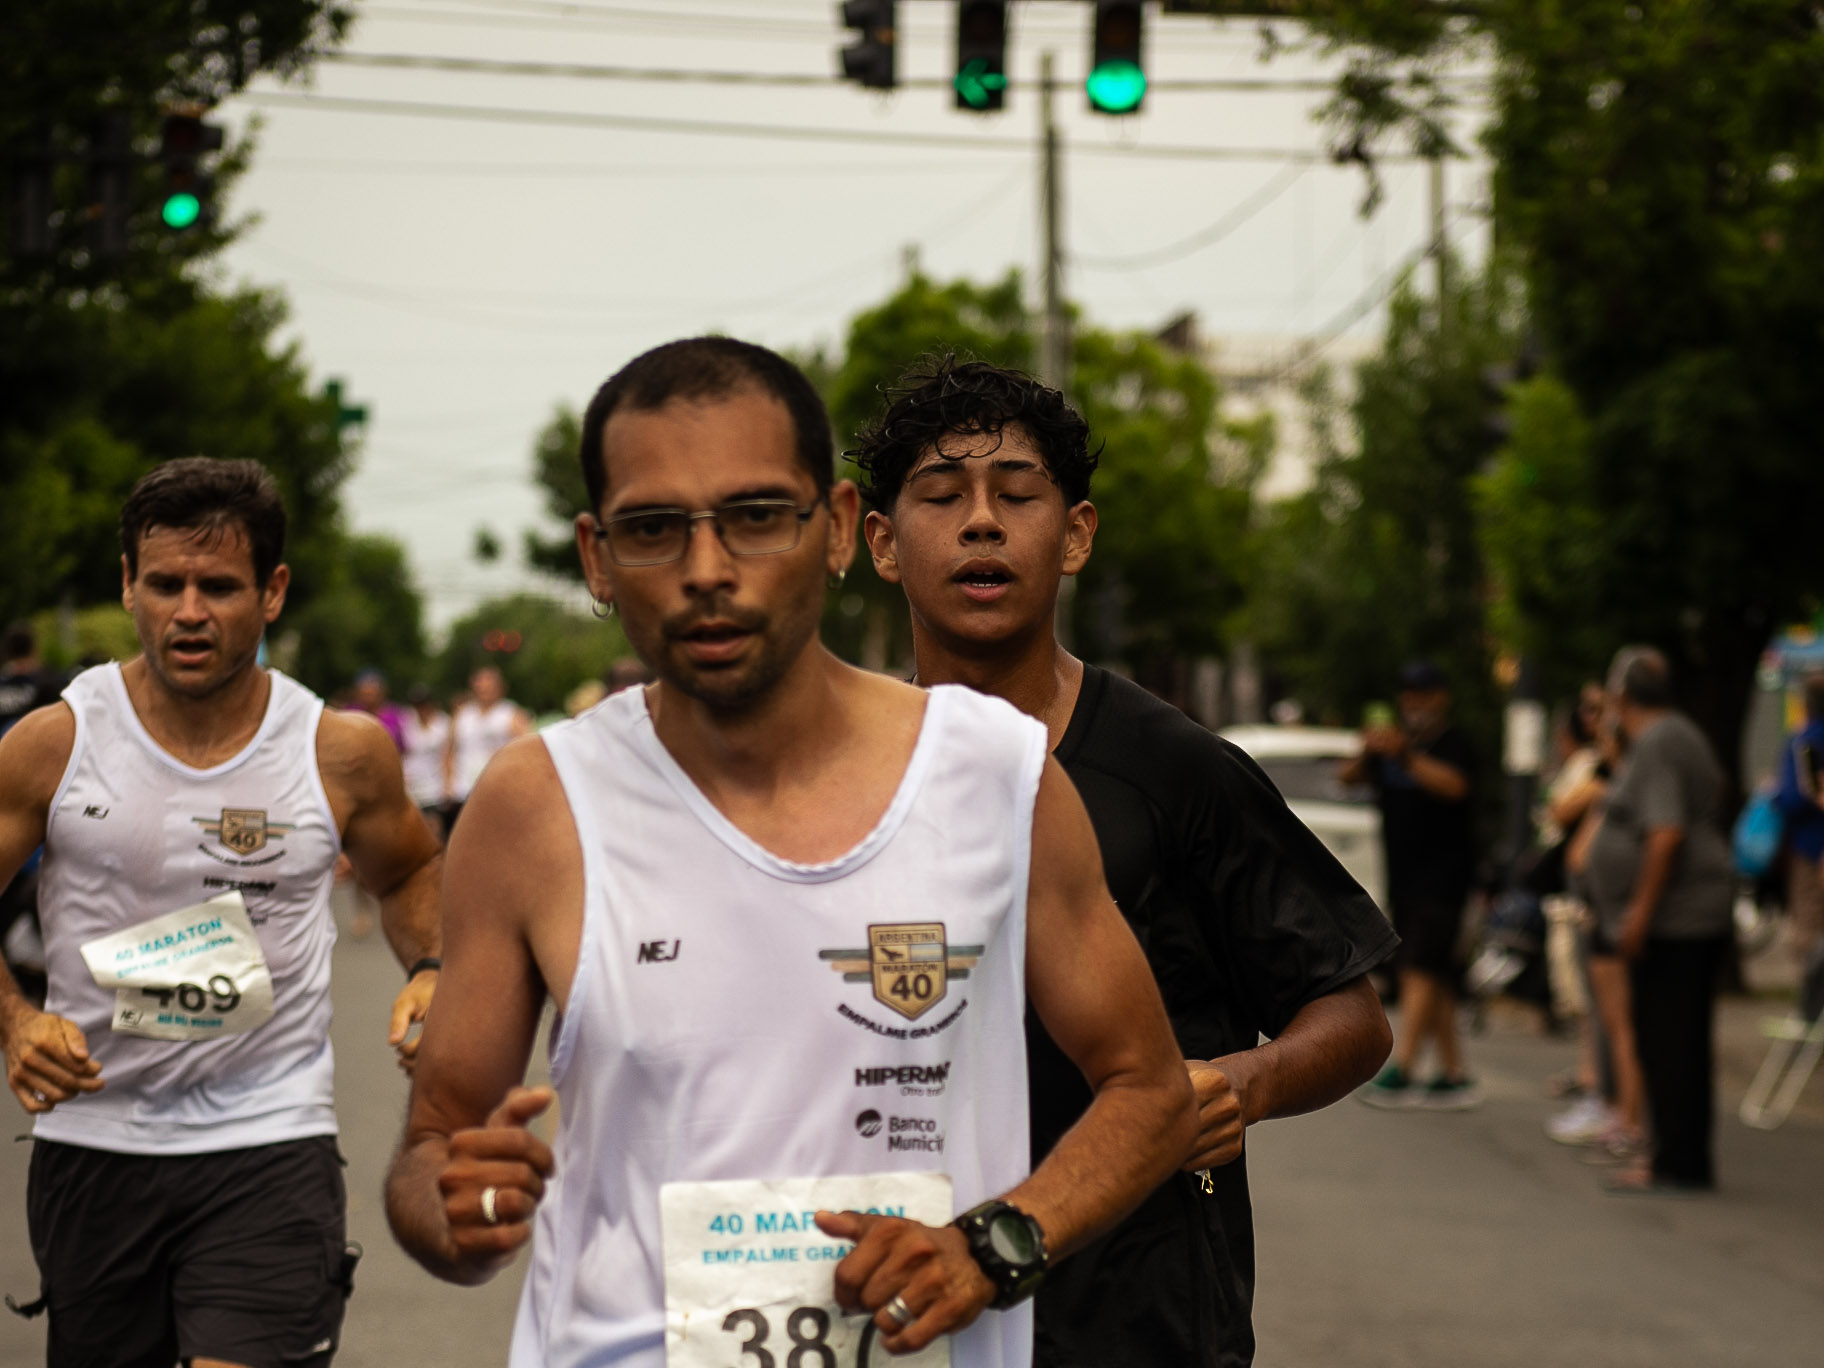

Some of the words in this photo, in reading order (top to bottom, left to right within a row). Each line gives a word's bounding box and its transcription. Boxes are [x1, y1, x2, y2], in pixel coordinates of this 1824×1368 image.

[138, 916, 223, 955] MARATON
[637, 939, 681, 964] NEJ
[890, 973, 933, 1001] 40
[888, 1116, 936, 1132] Banco
[709, 1213, 744, 1235] 40
[703, 1248, 799, 1265] EMPALME
